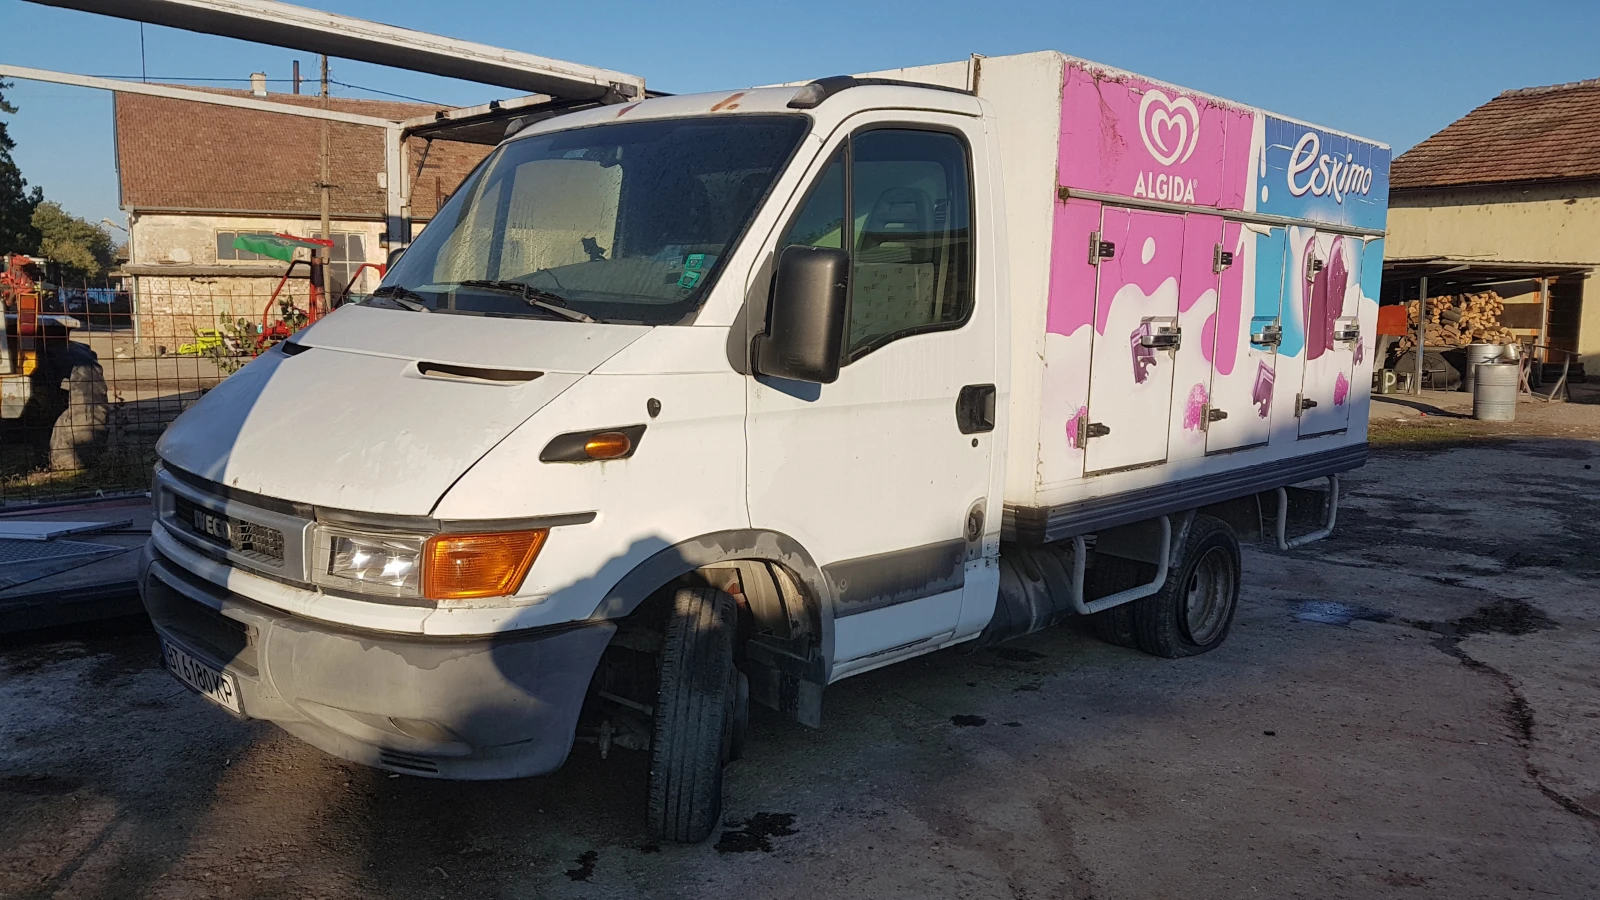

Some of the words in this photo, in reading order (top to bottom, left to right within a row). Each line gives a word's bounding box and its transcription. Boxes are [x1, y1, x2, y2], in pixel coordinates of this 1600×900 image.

[1133, 169, 1196, 204] ALGIDA
[1384, 372, 1396, 393] P
[193, 509, 232, 541] IVECO
